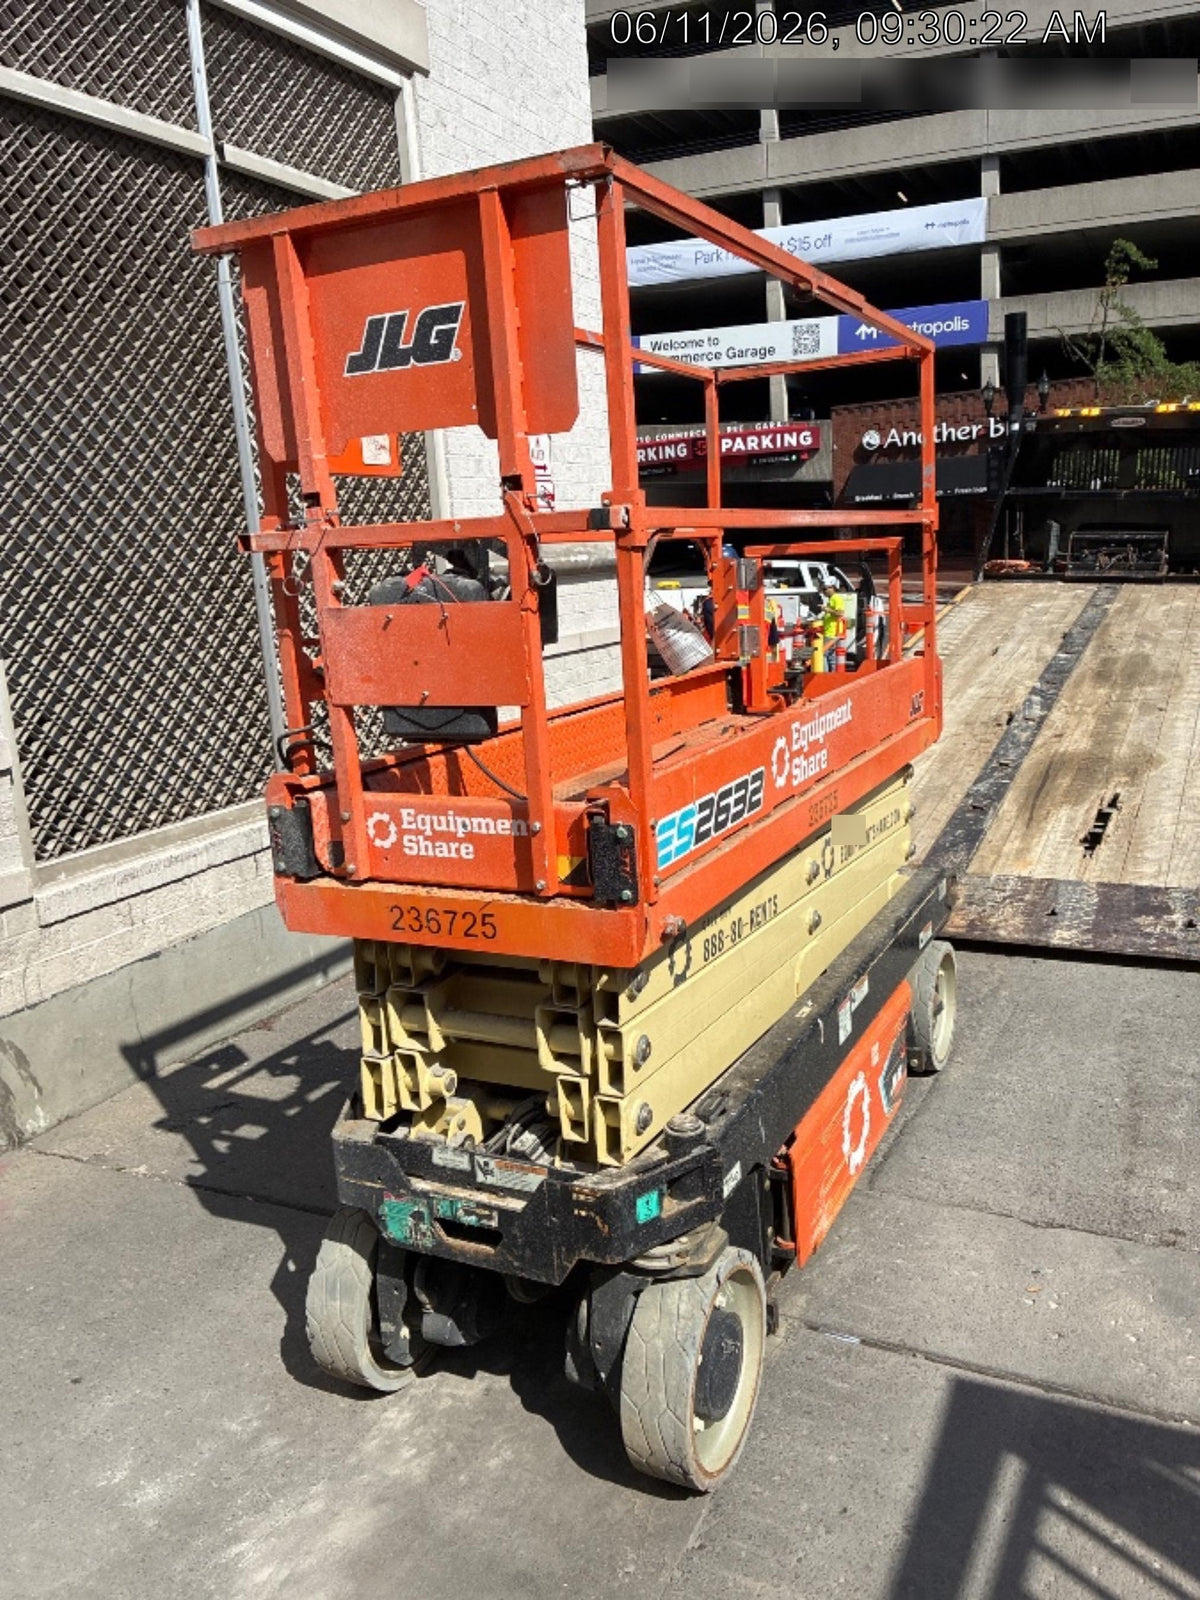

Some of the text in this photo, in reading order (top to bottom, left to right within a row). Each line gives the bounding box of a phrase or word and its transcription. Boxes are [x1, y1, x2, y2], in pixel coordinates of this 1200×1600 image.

[694, 249, 722, 265] Park
[787, 236, 811, 253] $15
[814, 233, 832, 250] off
[343, 300, 467, 377] JLG
[890, 316, 970, 337] tropolis
[650, 336, 720, 352] Welcome to
[670, 344, 776, 364] mmerce Garage
[637, 442, 688, 463] RKING
[721, 430, 813, 453] PARKING
[791, 698, 853, 750] Equipment
[791, 748, 828, 786] Share
[400, 808, 529, 838] Equipmen
[656, 766, 765, 871] ES2632
[402, 834, 475, 860] Share
[389, 904, 497, 940] 236725
